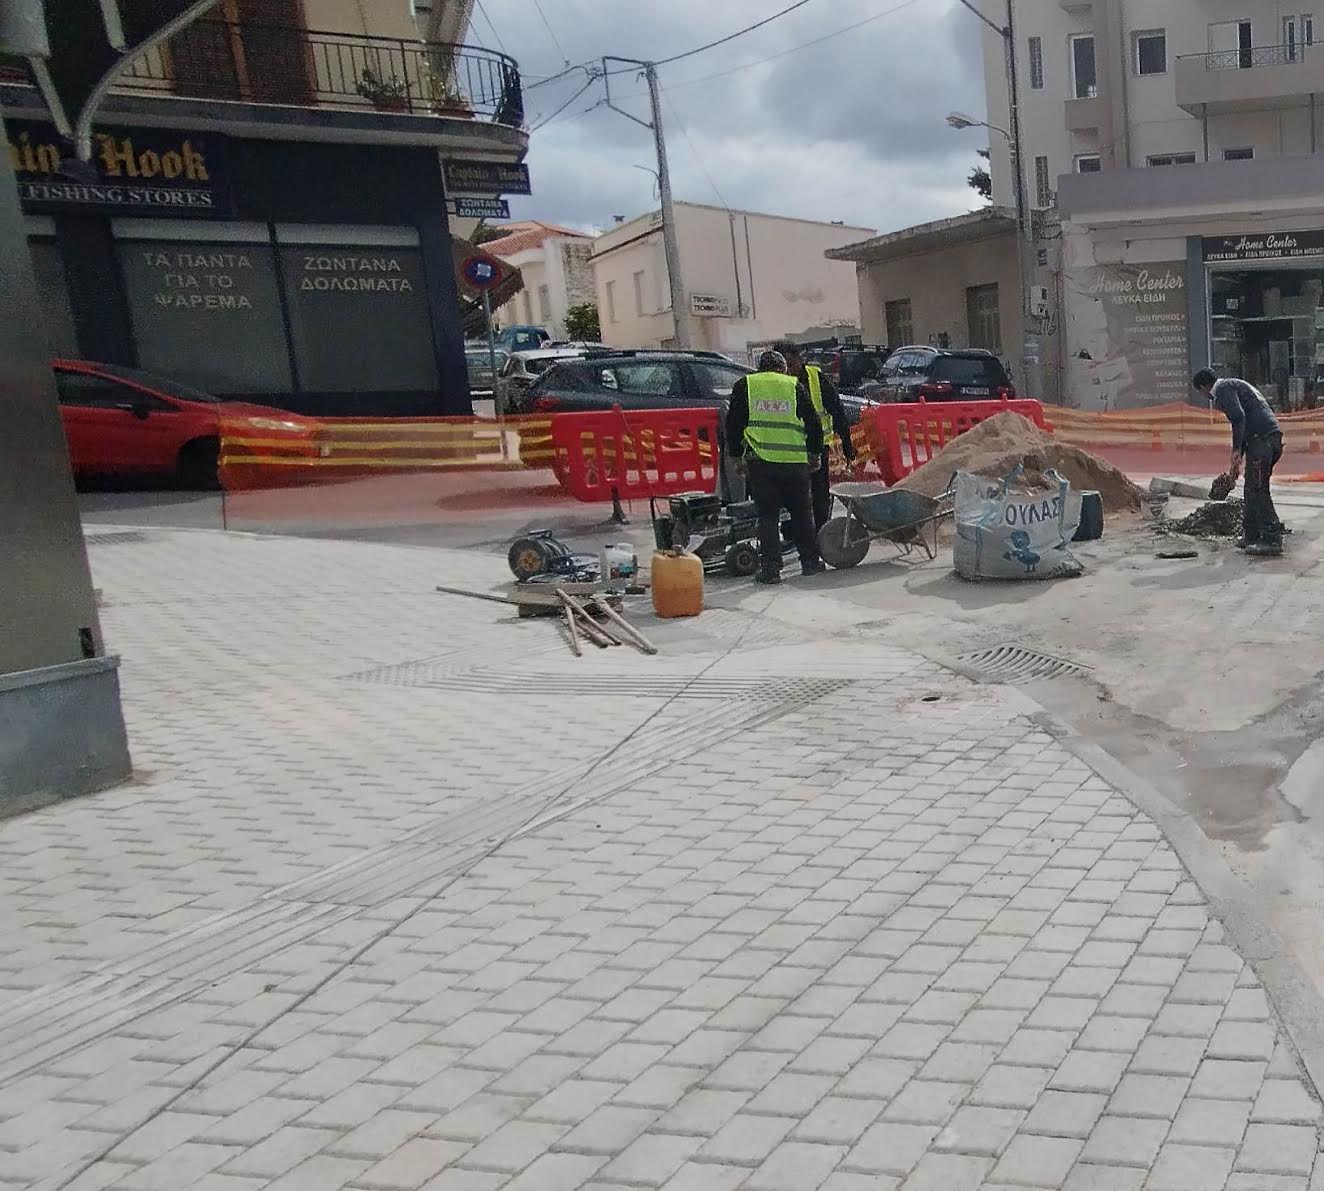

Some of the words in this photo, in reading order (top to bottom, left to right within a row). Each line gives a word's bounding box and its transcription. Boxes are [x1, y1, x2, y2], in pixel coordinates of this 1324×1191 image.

[96, 133, 209, 180] Hook
[28, 184, 123, 202] FISHING
[129, 189, 213, 206] STORES
[1235, 236, 1264, 251] Home
[1266, 234, 1297, 249] Center
[143, 252, 171, 267] ΤΑ
[177, 253, 252, 269] ΠΑΝΤΑ
[304, 256, 401, 272] ΖΩΝΤΑΝΑ
[164, 274, 198, 288] ΓΙΑ
[207, 274, 234, 289] ΤΟ
[301, 277, 414, 292] ΔΟΛΩΜΑΤΑ
[1090, 270, 1133, 293] Home
[1136, 269, 1185, 291] Center
[154, 293, 253, 309] ΨΑΡΕΜΑ
[1112, 294, 1142, 304] ΛΕΥΚΑ
[1143, 293, 1166, 302] ΕΙΔΗ
[1000, 496, 1061, 526] ΟΥΛΑΣ
